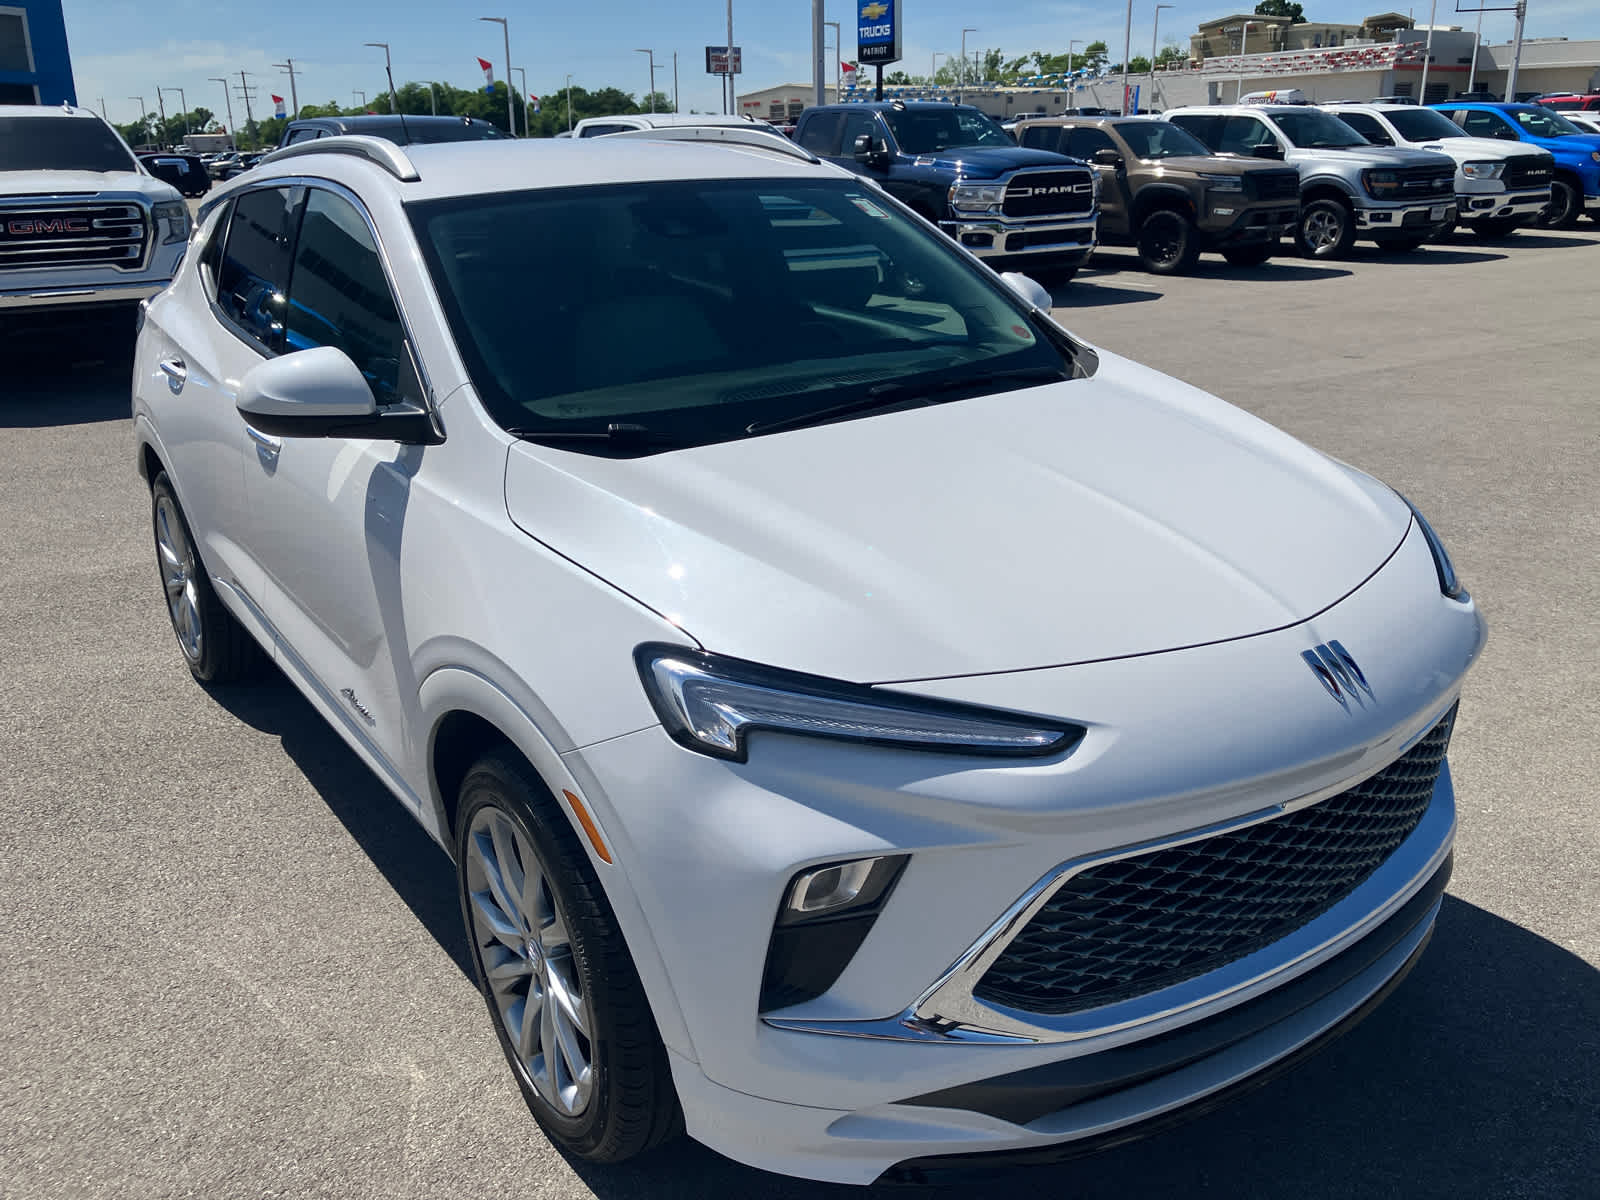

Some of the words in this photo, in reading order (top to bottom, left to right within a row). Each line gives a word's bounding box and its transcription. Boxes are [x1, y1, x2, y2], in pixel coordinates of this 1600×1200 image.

[859, 24, 890, 38] TRUCKS
[863, 46, 887, 56] PATRIOT
[1034, 185, 1072, 195] RAM
[8, 218, 89, 234] GMC
